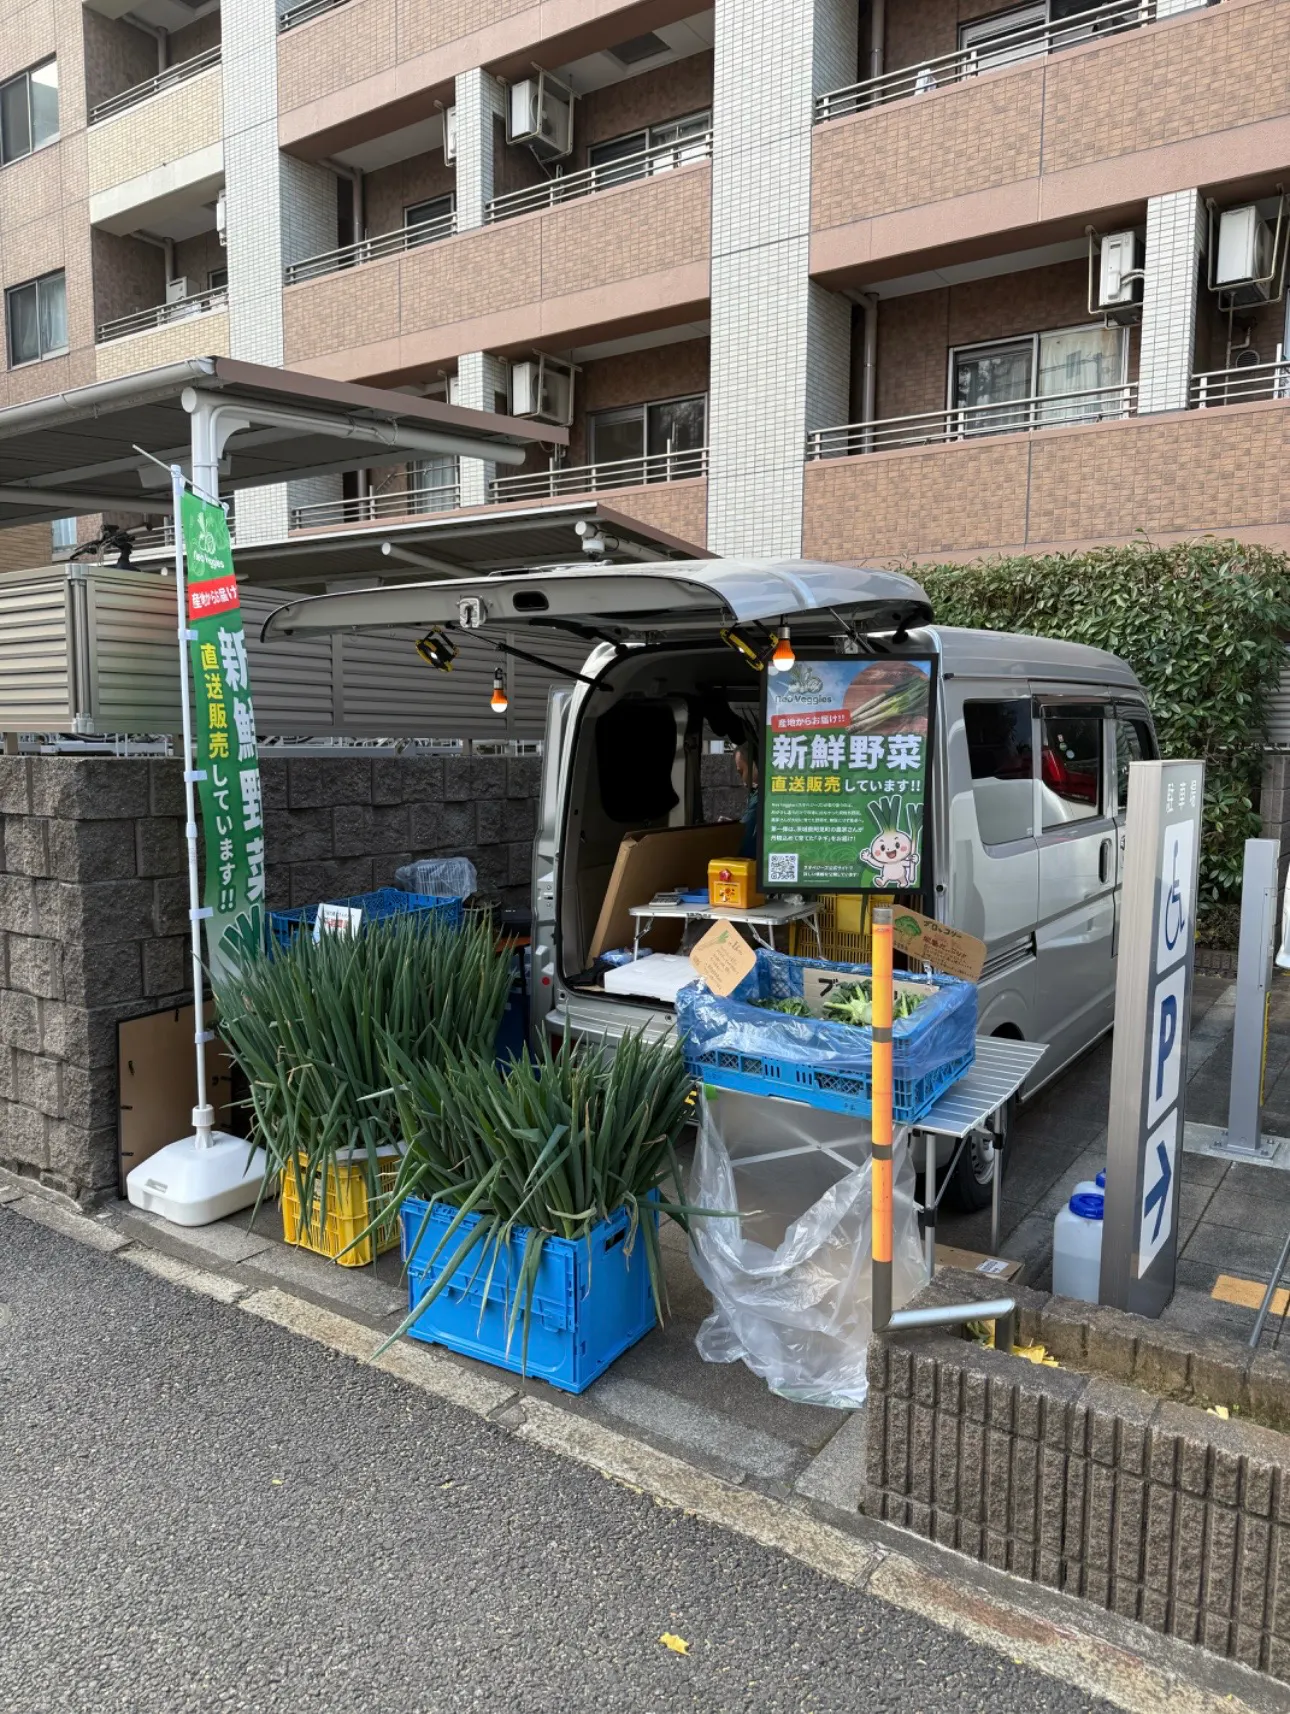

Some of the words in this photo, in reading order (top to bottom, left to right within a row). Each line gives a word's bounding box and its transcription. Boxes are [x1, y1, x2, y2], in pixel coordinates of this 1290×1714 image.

[795, 694, 832, 705] Veggies
[772, 734, 922, 770] 新鮮野菜
[1165, 780, 1197, 814] 駐車場
[1155, 994, 1177, 1102] P
